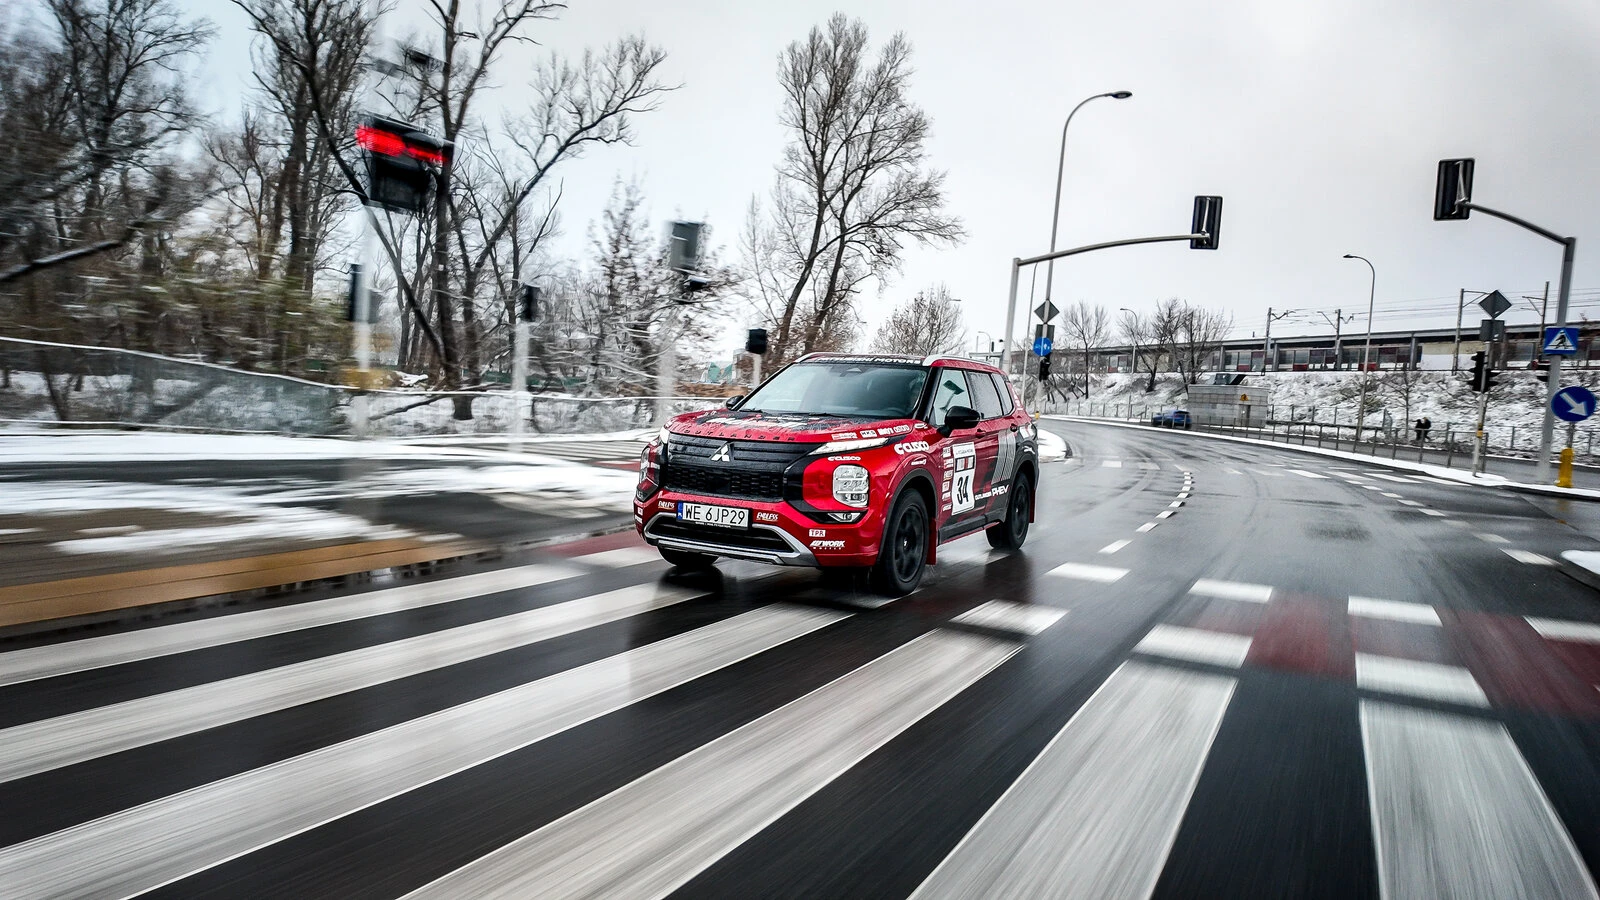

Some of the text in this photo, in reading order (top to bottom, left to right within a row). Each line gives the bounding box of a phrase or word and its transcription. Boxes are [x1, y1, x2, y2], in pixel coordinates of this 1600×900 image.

[684, 429, 795, 441] OUTLANDER
[957, 475, 969, 505] 34
[992, 485, 1009, 496] PHEV
[685, 505, 701, 516] WE
[706, 507, 745, 525] 6JP29
